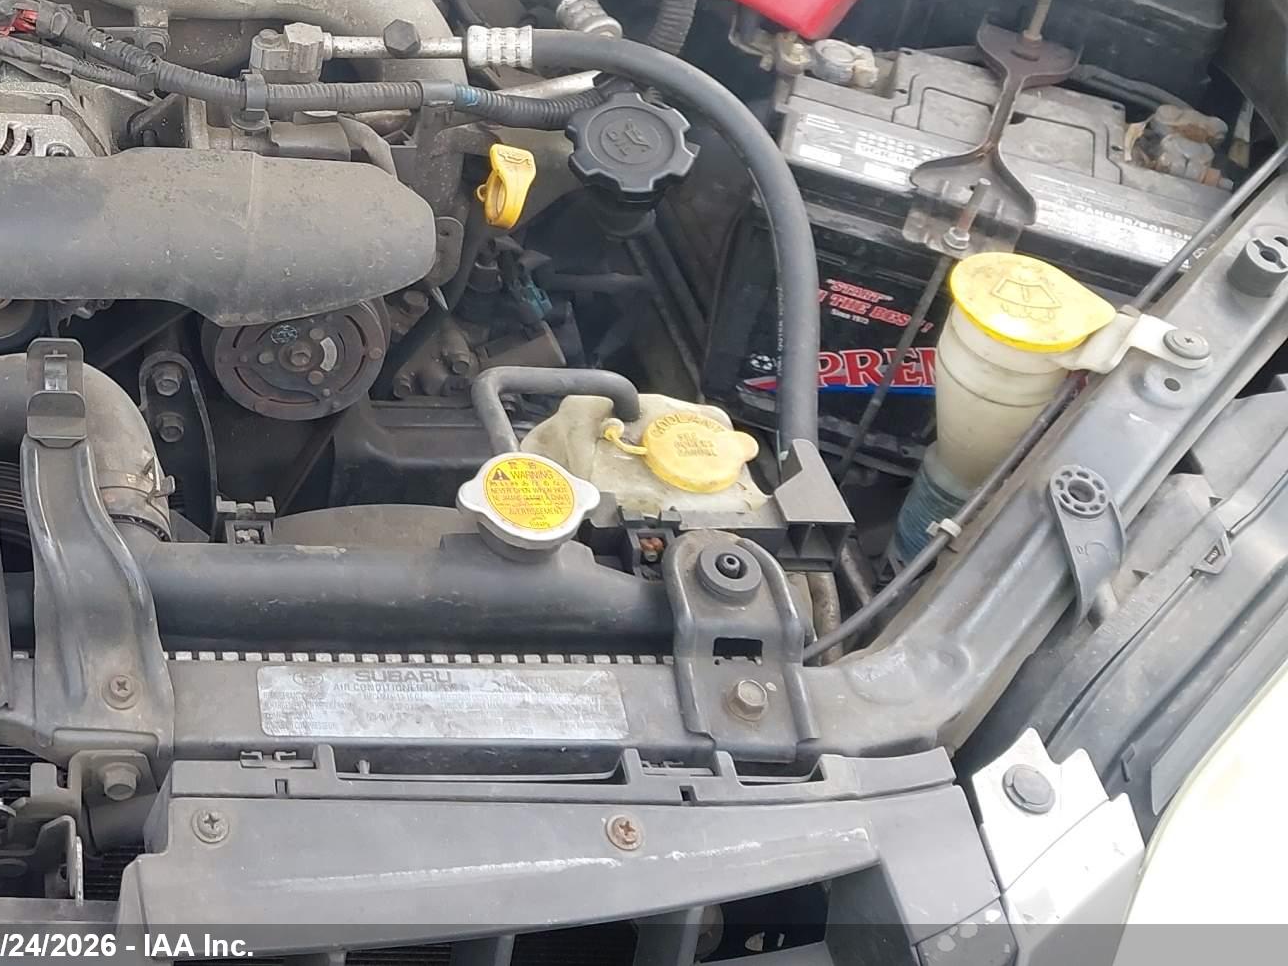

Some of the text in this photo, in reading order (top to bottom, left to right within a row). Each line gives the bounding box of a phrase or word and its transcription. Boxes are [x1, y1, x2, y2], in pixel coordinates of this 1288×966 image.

[829, 293, 872, 315] THE
[869, 305, 934, 333] BES!
[510, 470, 554, 480] WARNING
[354, 670, 452, 682] SUBARU
